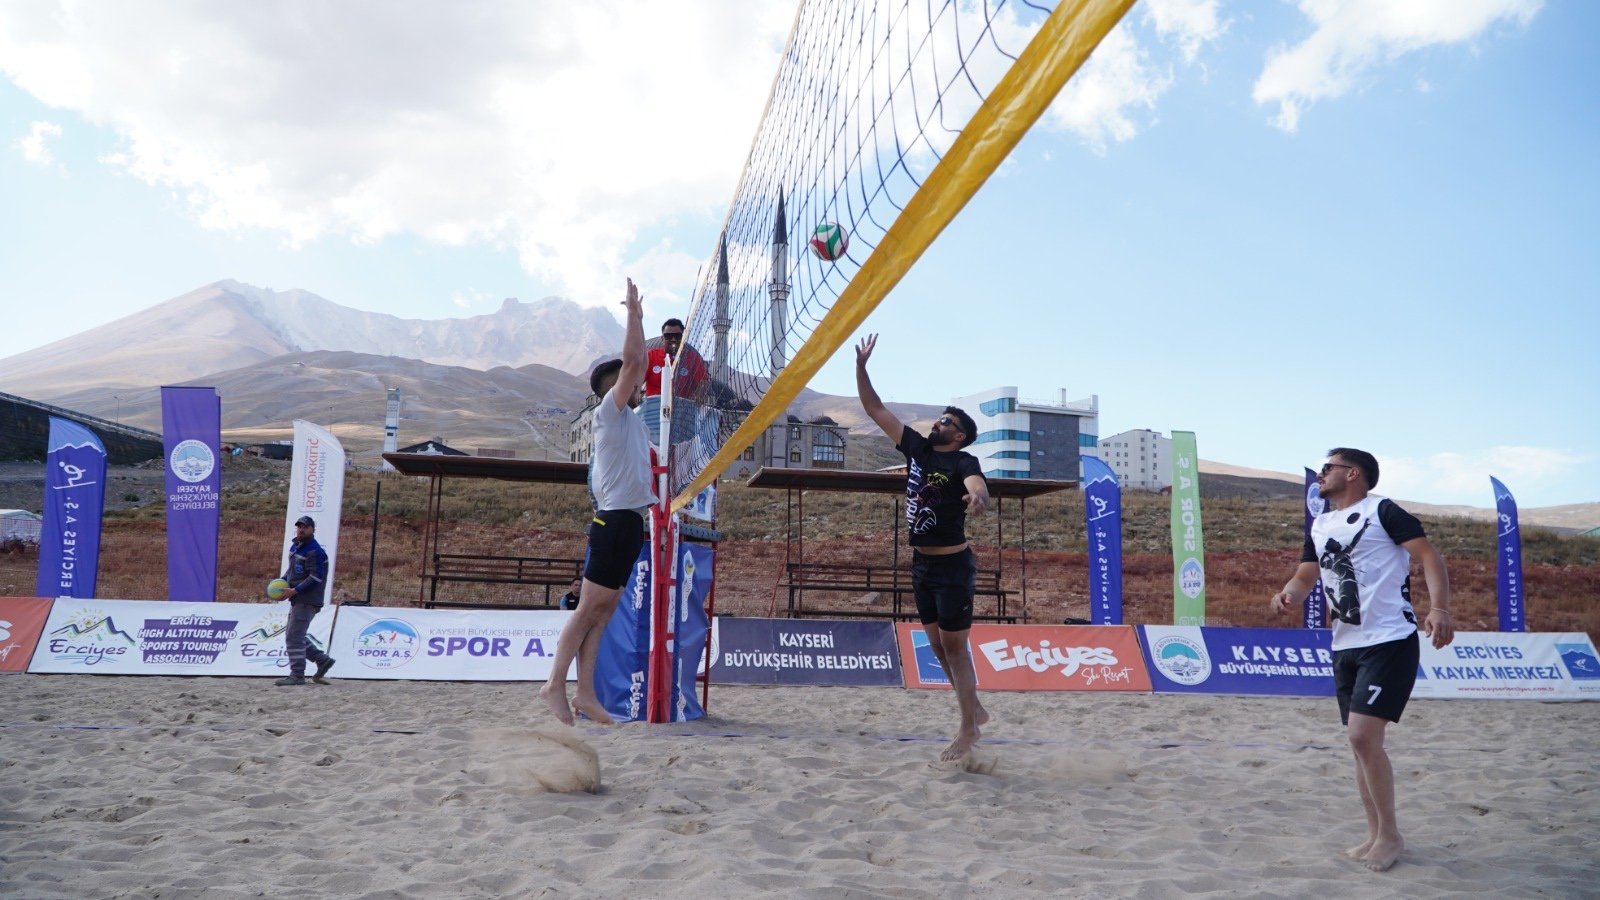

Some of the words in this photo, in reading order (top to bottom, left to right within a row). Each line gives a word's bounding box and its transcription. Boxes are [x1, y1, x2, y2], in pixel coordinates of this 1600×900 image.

[634, 560, 649, 610] Erciyes
[170, 614, 212, 626] ERCİYES
[137, 629, 166, 639] HIGH
[165, 629, 214, 639] ALTITUDE
[214, 630, 238, 640] AND
[429, 627, 466, 636] KAYSERİ
[525, 628, 561, 637] BELEDİY
[779, 631, 834, 648] KAYSERİ
[50, 639, 127, 665] Erciyes
[139, 641, 180, 651] SPORTS
[182, 642, 228, 652] TOURISM
[358, 649, 388, 657] SPOR
[392, 650, 412, 660] A.Ş.
[427, 636, 511, 657] SPOR
[523, 638, 559, 657] A.
[1232, 645, 1332, 664] KAYSER
[1453, 643, 1523, 659] ERCİYES
[145, 653, 213, 664] ASSOCIATION
[725, 649, 814, 671] BÜYÜKŞEHİR
[817, 652, 892, 670] BELEDİYESİ
[978, 639, 1118, 677] Erciyes
[1101, 665, 1134, 685] Resort
[1218, 662, 1299, 677] BÜYÜKŞEHİR
[1432, 666, 1490, 680] KAYAK
[1491, 664, 1564, 680] MERKEZİ
[630, 671, 645, 719] Erciyes
[1367, 685, 1382, 705] 7
